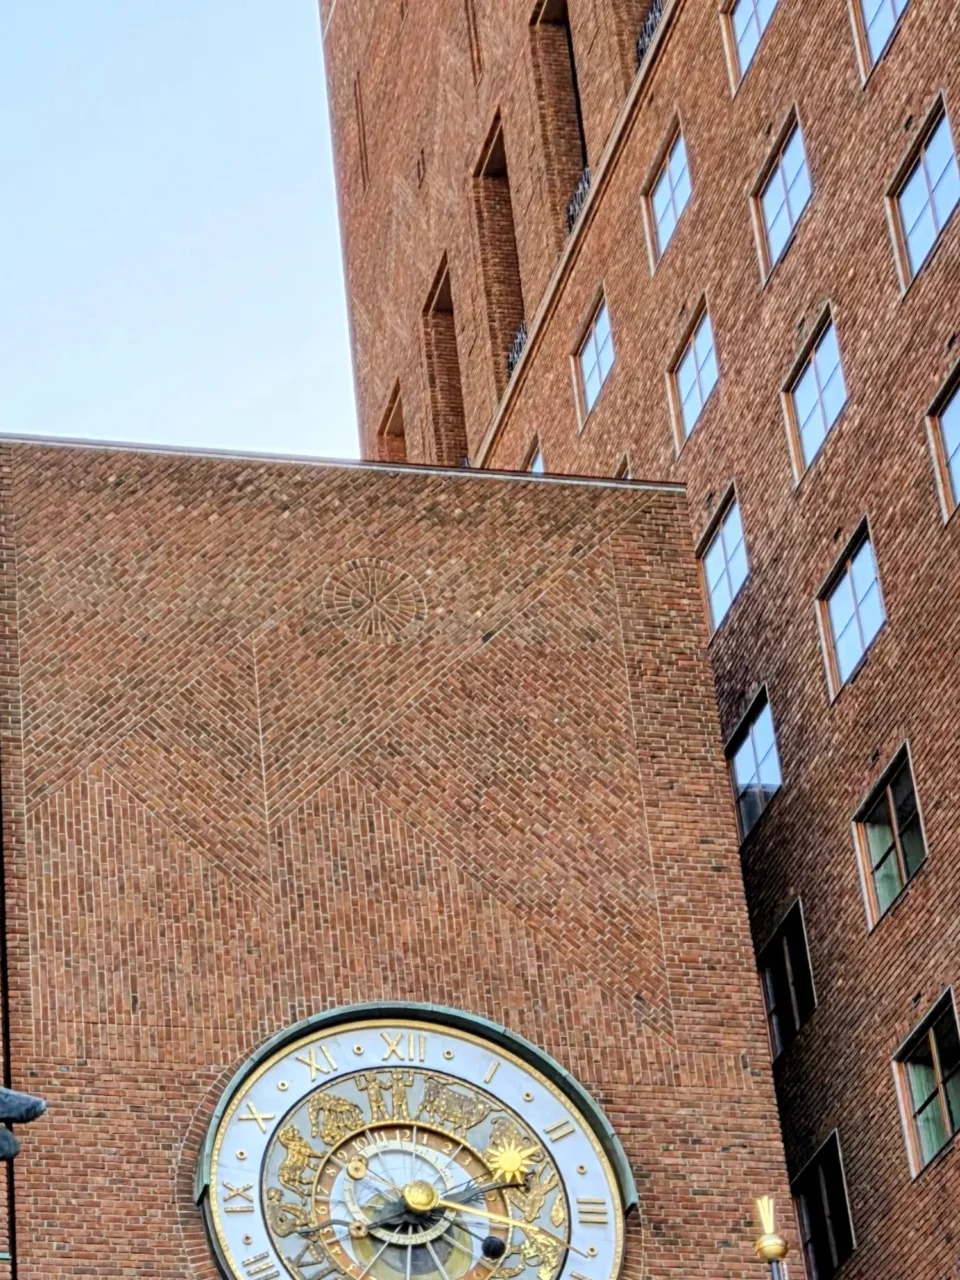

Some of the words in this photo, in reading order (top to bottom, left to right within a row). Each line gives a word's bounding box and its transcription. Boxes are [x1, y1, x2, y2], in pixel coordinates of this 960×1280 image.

[380, 1031, 426, 1062] XII
[295, 1045, 338, 1082] XI
[238, 1101, 275, 1134] X
[374, 1131, 387, 1143] 11
[394, 1129, 411, 1141] 12
[543, 1119, 576, 1143] II
[351, 1137, 368, 1151] 10
[441, 1142, 453, 1154] 2
[223, 1180, 254, 1213] IX
[317, 1185, 329, 1195] 7
[576, 1197, 608, 1224] III
